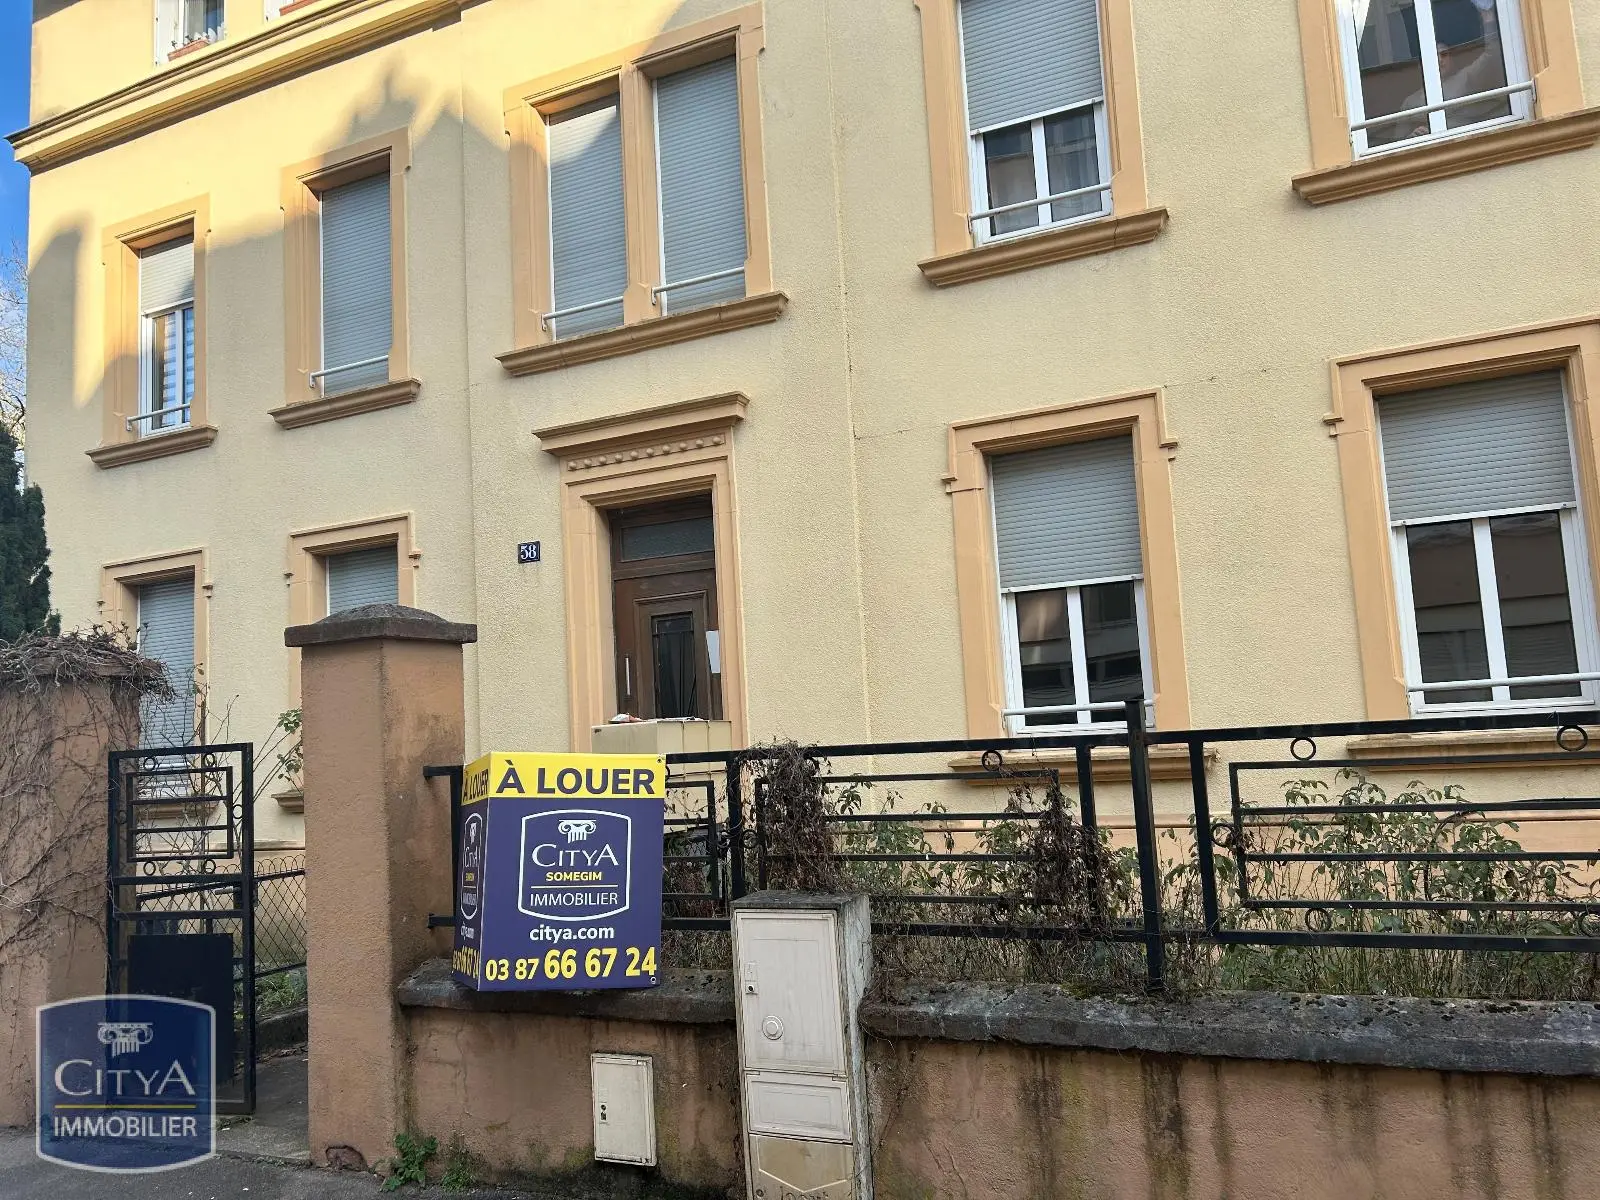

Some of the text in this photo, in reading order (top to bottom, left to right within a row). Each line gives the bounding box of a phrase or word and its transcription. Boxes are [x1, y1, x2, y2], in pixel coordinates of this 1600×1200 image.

[520, 544, 537, 560] 58
[496, 760, 655, 795] À LOUER
[546, 871, 603, 882] SOMEGIM
[530, 892, 618, 907] IMMOBILIER
[529, 924, 615, 943] citya.com
[485, 958, 509, 981] 03
[514, 958, 540, 980] 87
[544, 948, 577, 979] 66
[584, 947, 618, 978] 67
[625, 946, 657, 976] 24
